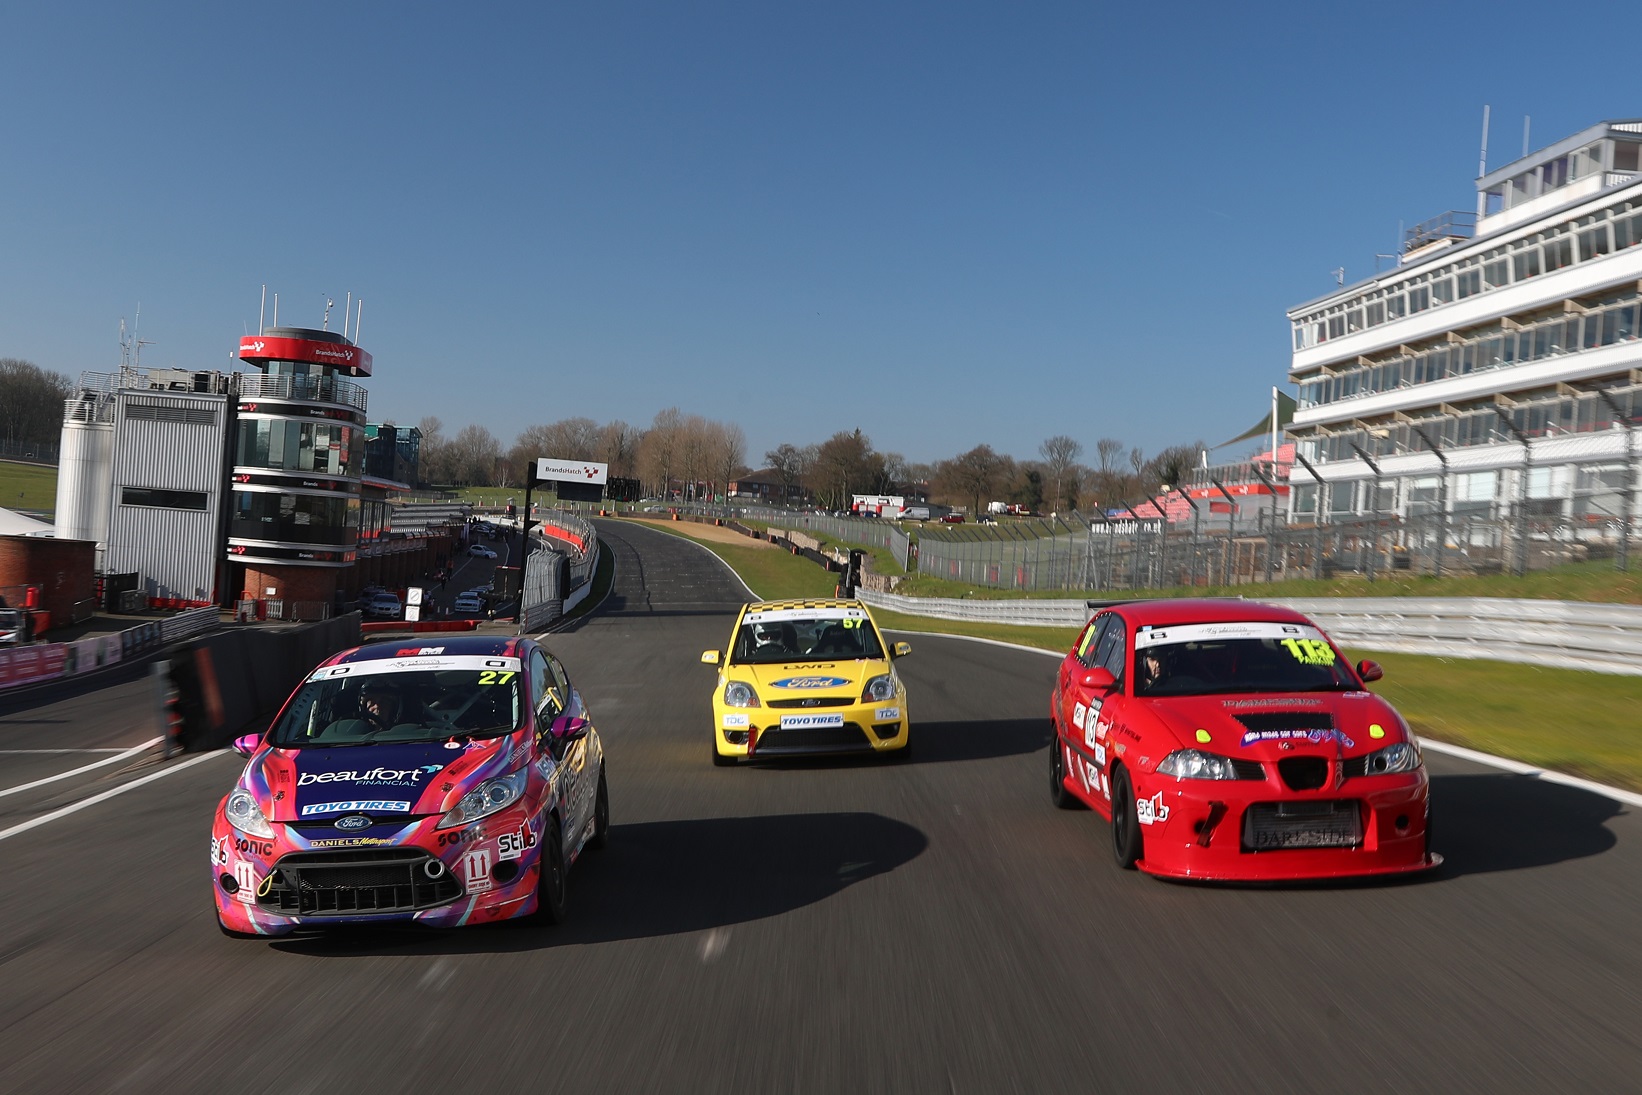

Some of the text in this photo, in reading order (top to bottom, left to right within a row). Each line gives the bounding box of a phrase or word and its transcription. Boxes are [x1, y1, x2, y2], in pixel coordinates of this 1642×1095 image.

[545, 466, 582, 475] BrandsHatch
[842, 618, 863, 629] 57
[1280, 638, 1336, 660] 113
[477, 670, 516, 685] 27
[787, 676, 834, 688] Ford
[782, 715, 842, 725] TOYO TIRES
[296, 766, 423, 788] beaufort
[355, 779, 418, 788] FINANCIAL
[305, 800, 408, 814] TOYO TIRES
[340, 816, 364, 829] Ford
[310, 837, 399, 848] DANIELS Motorsport
